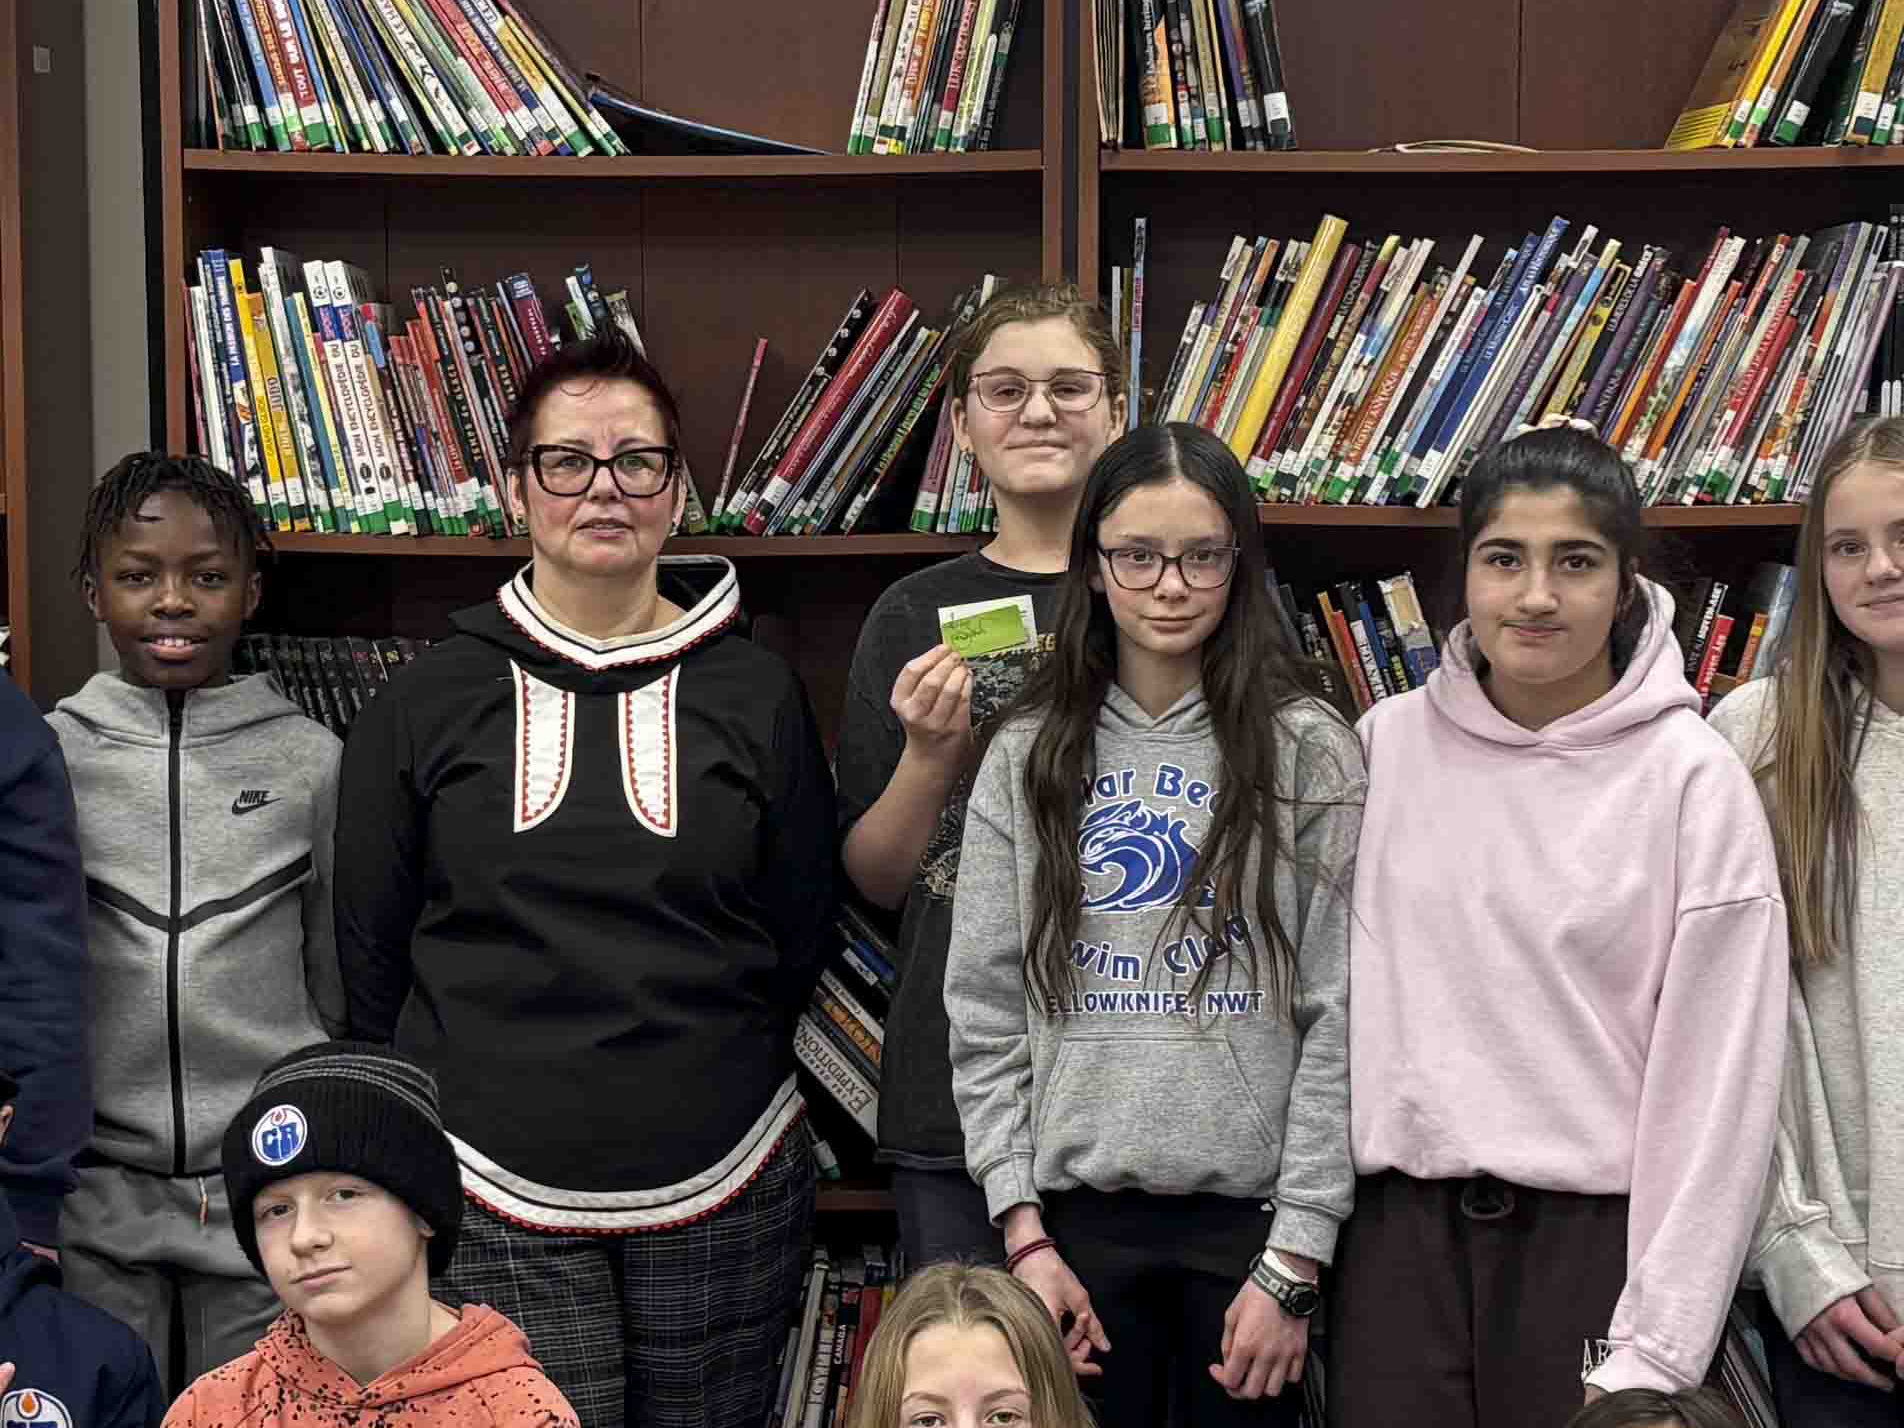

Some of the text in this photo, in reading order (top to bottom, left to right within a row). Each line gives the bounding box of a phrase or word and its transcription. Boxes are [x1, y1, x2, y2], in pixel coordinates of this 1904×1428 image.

[265, 375, 284, 413] JUDO
[239, 788, 271, 804] NIKE
[1153, 762, 1218, 817] Be
[1070, 938, 1143, 981] wim
[1046, 990, 1264, 1017] ELLOWKNIFE, NWT
[789, 1025, 877, 1117] EXPEDITION
